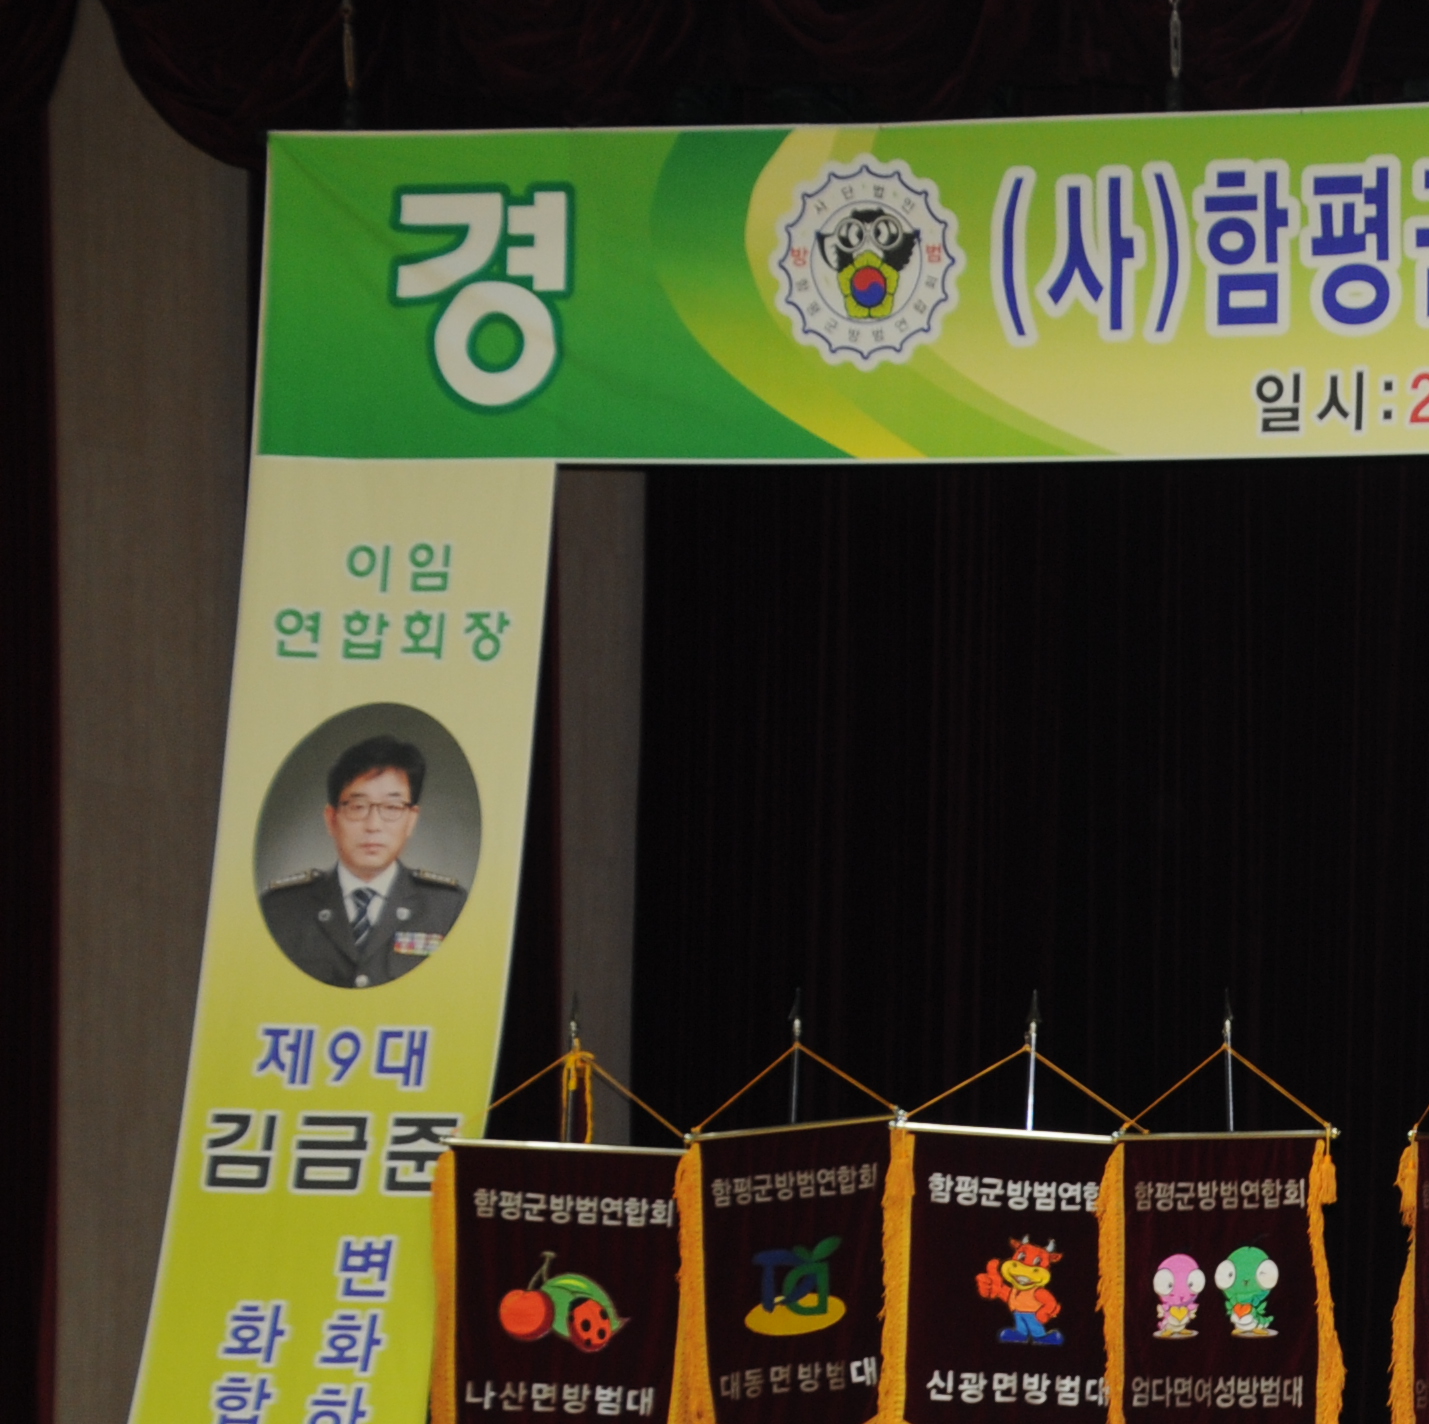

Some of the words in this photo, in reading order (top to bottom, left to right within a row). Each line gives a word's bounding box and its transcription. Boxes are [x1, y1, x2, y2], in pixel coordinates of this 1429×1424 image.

[397, 189, 568, 407] 경
[346, 542, 452, 593] 이임
[274, 608, 511, 662] 연합회장
[256, 1026, 431, 1088] 제9대
[203, 1111, 460, 1193] 김금준
[473, 1187, 676, 1228] 함평군방범연합회
[710, 1163, 878, 1208] 함평군방범연합회
[927, 1171, 1100, 1212] 함평군방범연합
[1133, 1177, 1306, 1212] 함평군방범연합회
[465, 1379, 656, 1417] 나산면방범대
[719, 1356, 879, 1400] 대동면방범대
